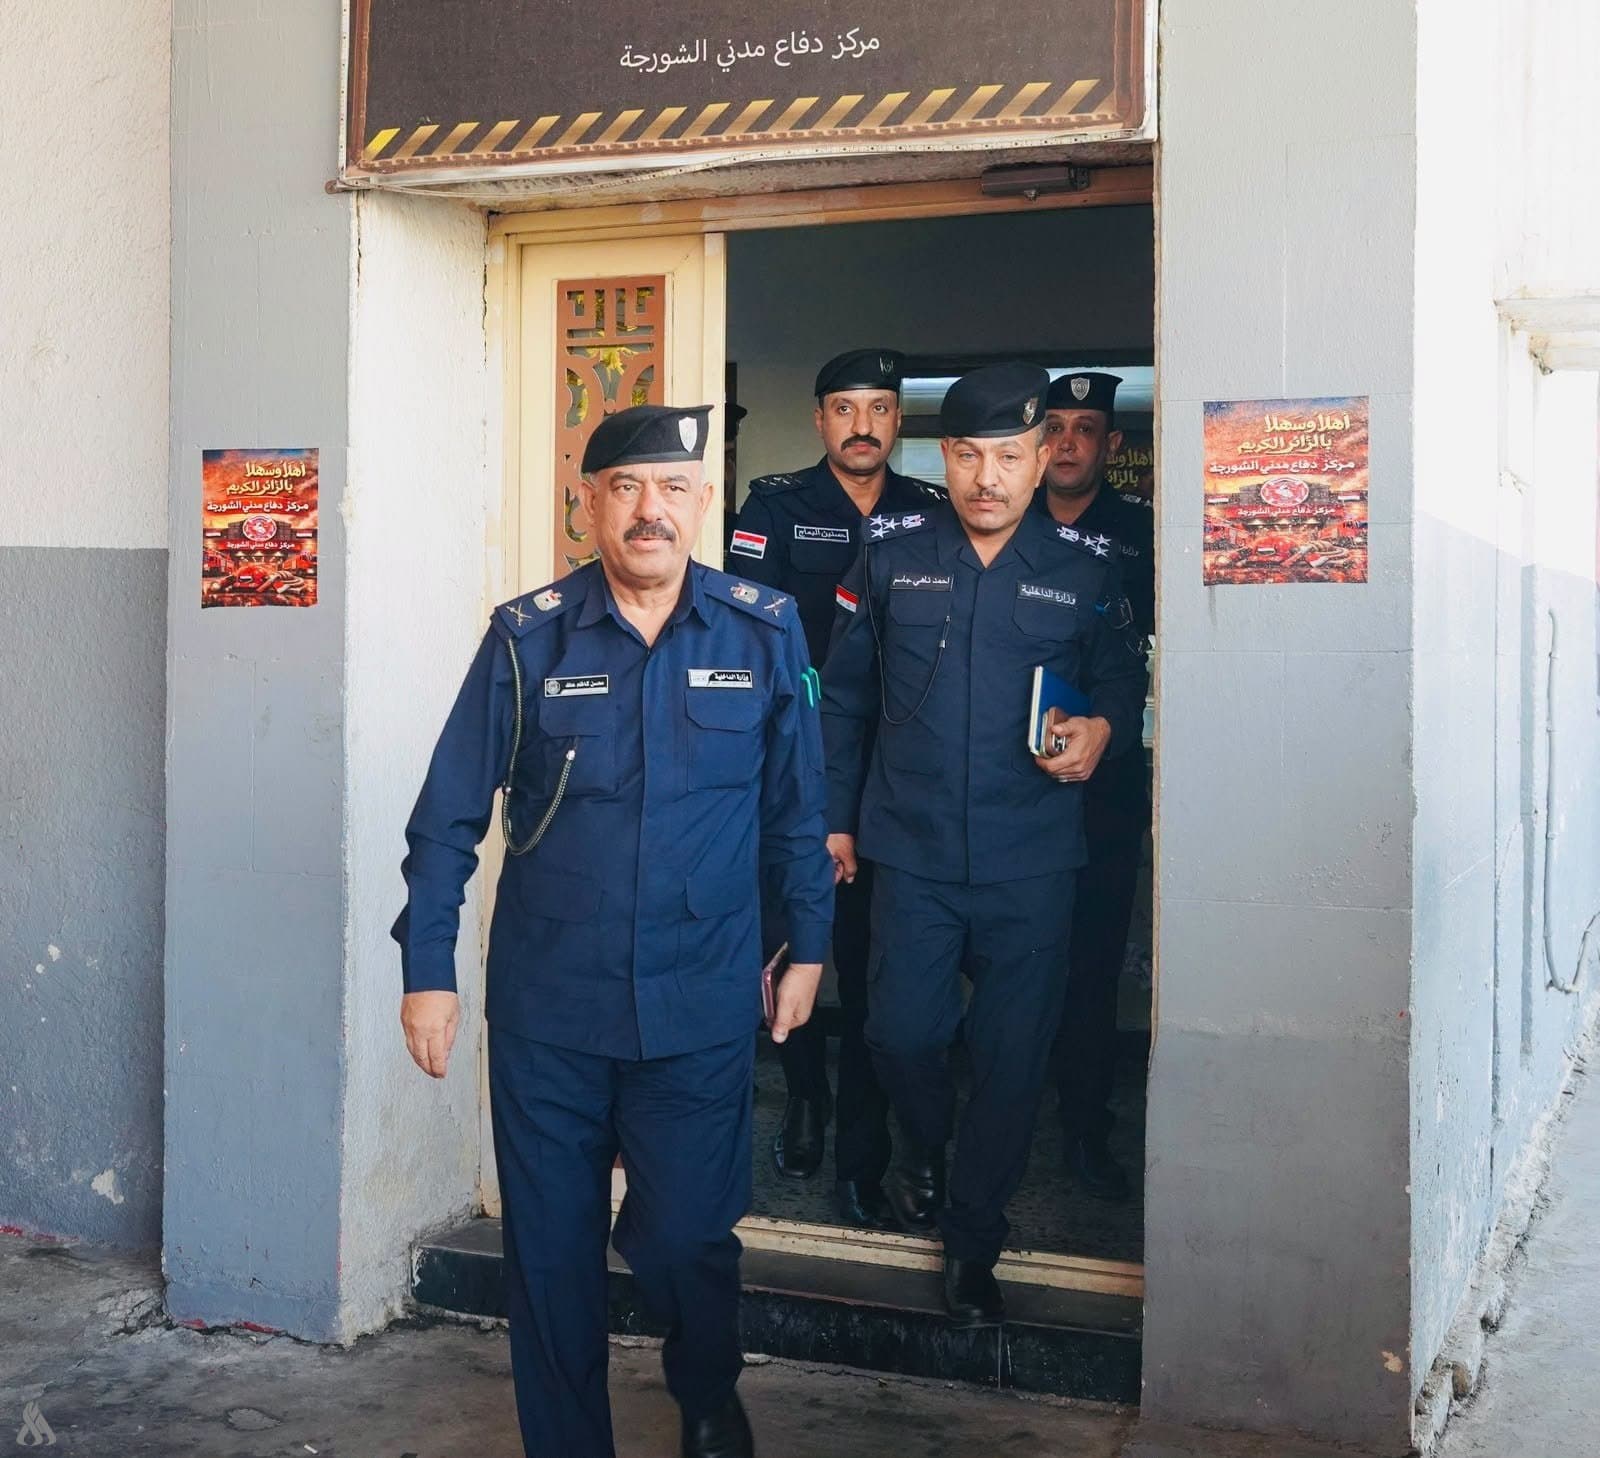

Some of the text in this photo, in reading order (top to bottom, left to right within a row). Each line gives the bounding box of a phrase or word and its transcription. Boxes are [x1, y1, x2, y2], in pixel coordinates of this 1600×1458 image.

[619, 27, 880, 73] مركز دفاع مدني الشورجة
[1209, 459, 1355, 474] مركز دفاع مدني الشورجة
[207, 500, 309, 513] مركز دفاع مدني الشورجة
[1055, 591, 1076, 605] وزارة
